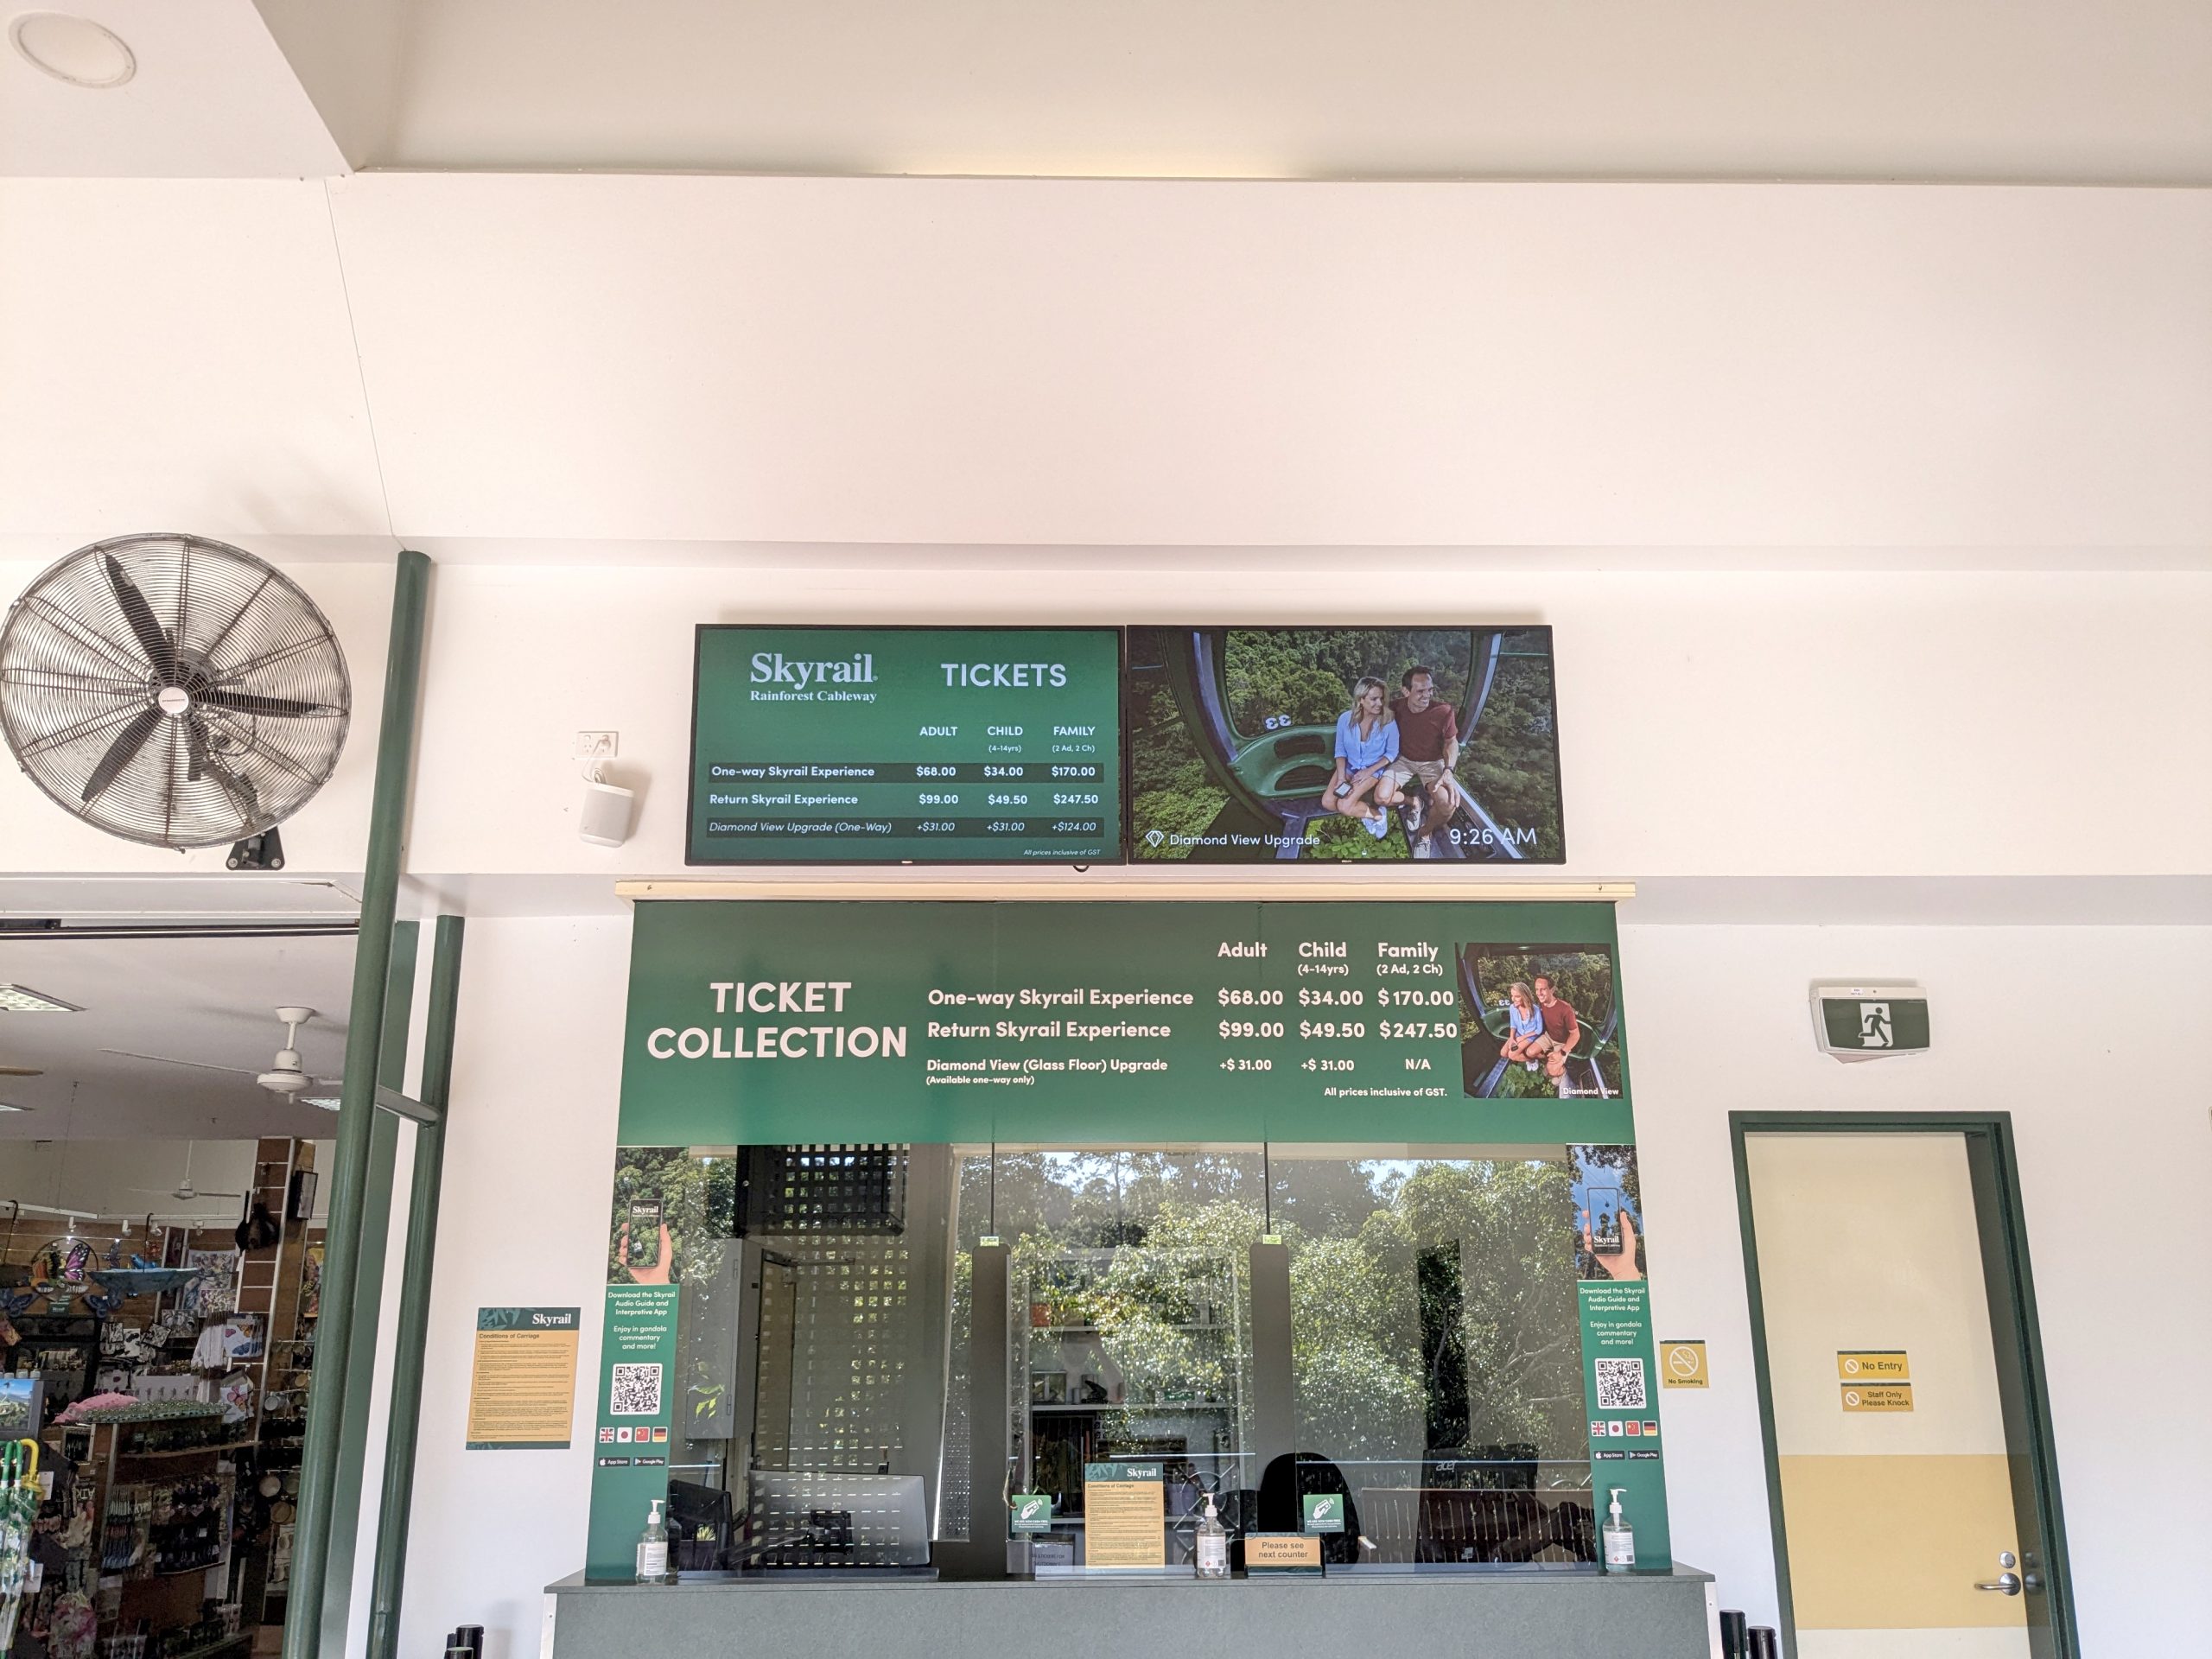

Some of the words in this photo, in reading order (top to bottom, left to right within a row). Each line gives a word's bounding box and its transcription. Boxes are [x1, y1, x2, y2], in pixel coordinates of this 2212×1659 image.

[750, 652, 873, 690] Skyrail
[941, 664, 1067, 687] TICKETS
[750, 691, 814, 701] Rainforest
[817, 690, 877, 703] Cableway
[919, 726, 957, 736] ADULT
[987, 726, 1023, 736] CHILD
[1052, 726, 1096, 736] FAMILY
[988, 744, 1022, 753] (4-14yrs)
[711, 766, 766, 779] One-way
[768, 766, 808, 779] Skyrail
[810, 766, 875, 779] Experience
[916, 765, 957, 778] $68.00
[983, 765, 1024, 778] $34.00
[1051, 765, 1096, 778] $170.00
[709, 794, 747, 805] Return
[751, 793, 792, 807] Skyrail
[794, 793, 858, 806] Experience
[918, 793, 959, 805] $99.00
[988, 793, 1027, 805] $49.50
[1053, 793, 1098, 805] $247.50
[709, 822, 757, 832] Diamond
[760, 822, 785, 832] View
[787, 822, 832, 834] Upgrade
[835, 821, 892, 835] (One-Way)
[917, 821, 955, 833] +$31.00
[987, 821, 1025, 833] +$31.00
[1052, 821, 1096, 833] +$124.00
[1169, 833, 1228, 846] Diamond
[1231, 833, 1261, 845] View
[1263, 833, 1320, 848] Upgrade
[1449, 829, 1493, 845] 9:26
[1500, 828, 1537, 845] AM
[1033, 849, 1051, 857] prices
[1217, 942, 1268, 958] Adult
[1298, 942, 1347, 958] Child
[1377, 942, 1439, 962] Family
[1297, 963, 1349, 976] (4-14yrs)
[1376, 963, 1389, 976] (2
[1391, 963, 1412, 976] Ad,
[1414, 964, 1421, 975] 2
[1424, 963, 1444, 976] Ch)
[709, 982, 852, 1013] TICKET
[928, 989, 1014, 1008] One-way
[1020, 988, 1084, 1008] Skyrail
[1090, 988, 1194, 1008] Experience
[1217, 988, 1284, 1008] $68.00
[1298, 988, 1363, 1008] $34.00
[928, 1021, 990, 1038] Return
[995, 1020, 1061, 1041] Skyrail
[1066, 1020, 1171, 1040] Experience
[1218, 1020, 1285, 1040] $99.00
[1300, 1020, 1365, 1040] $49.50
[647, 1027, 907, 1059] COLLECTION
[927, 1059, 987, 1071] Diamond
[989, 1059, 1020, 1071] View
[1023, 1058, 1066, 1074] (Glass
[1069, 1058, 1107, 1074] Floor)
[1110, 1059, 1168, 1074] Upgrade
[1405, 1058, 1432, 1071] N/A
[926, 1075, 970, 1086] (Available
[973, 1077, 1010, 1086] one-way
[1012, 1076, 1035, 1086] only)
[1324, 1087, 1337, 1096] All
[1338, 1087, 1368, 1098] prices
[1370, 1087, 1410, 1096] inclusive
[1413, 1087, 1424, 1096] of
[1426, 1087, 1448, 1096] GST.
[632, 1205, 658, 1215] Skyrail
[1593, 1236, 1620, 1245] Skyrail
[532, 1313, 572, 1327] Skyrail
[1862, 1362, 1875, 1370] No
[1878, 1362, 1903, 1372] Entry
[1127, 1467, 1157, 1478] Skyrail
